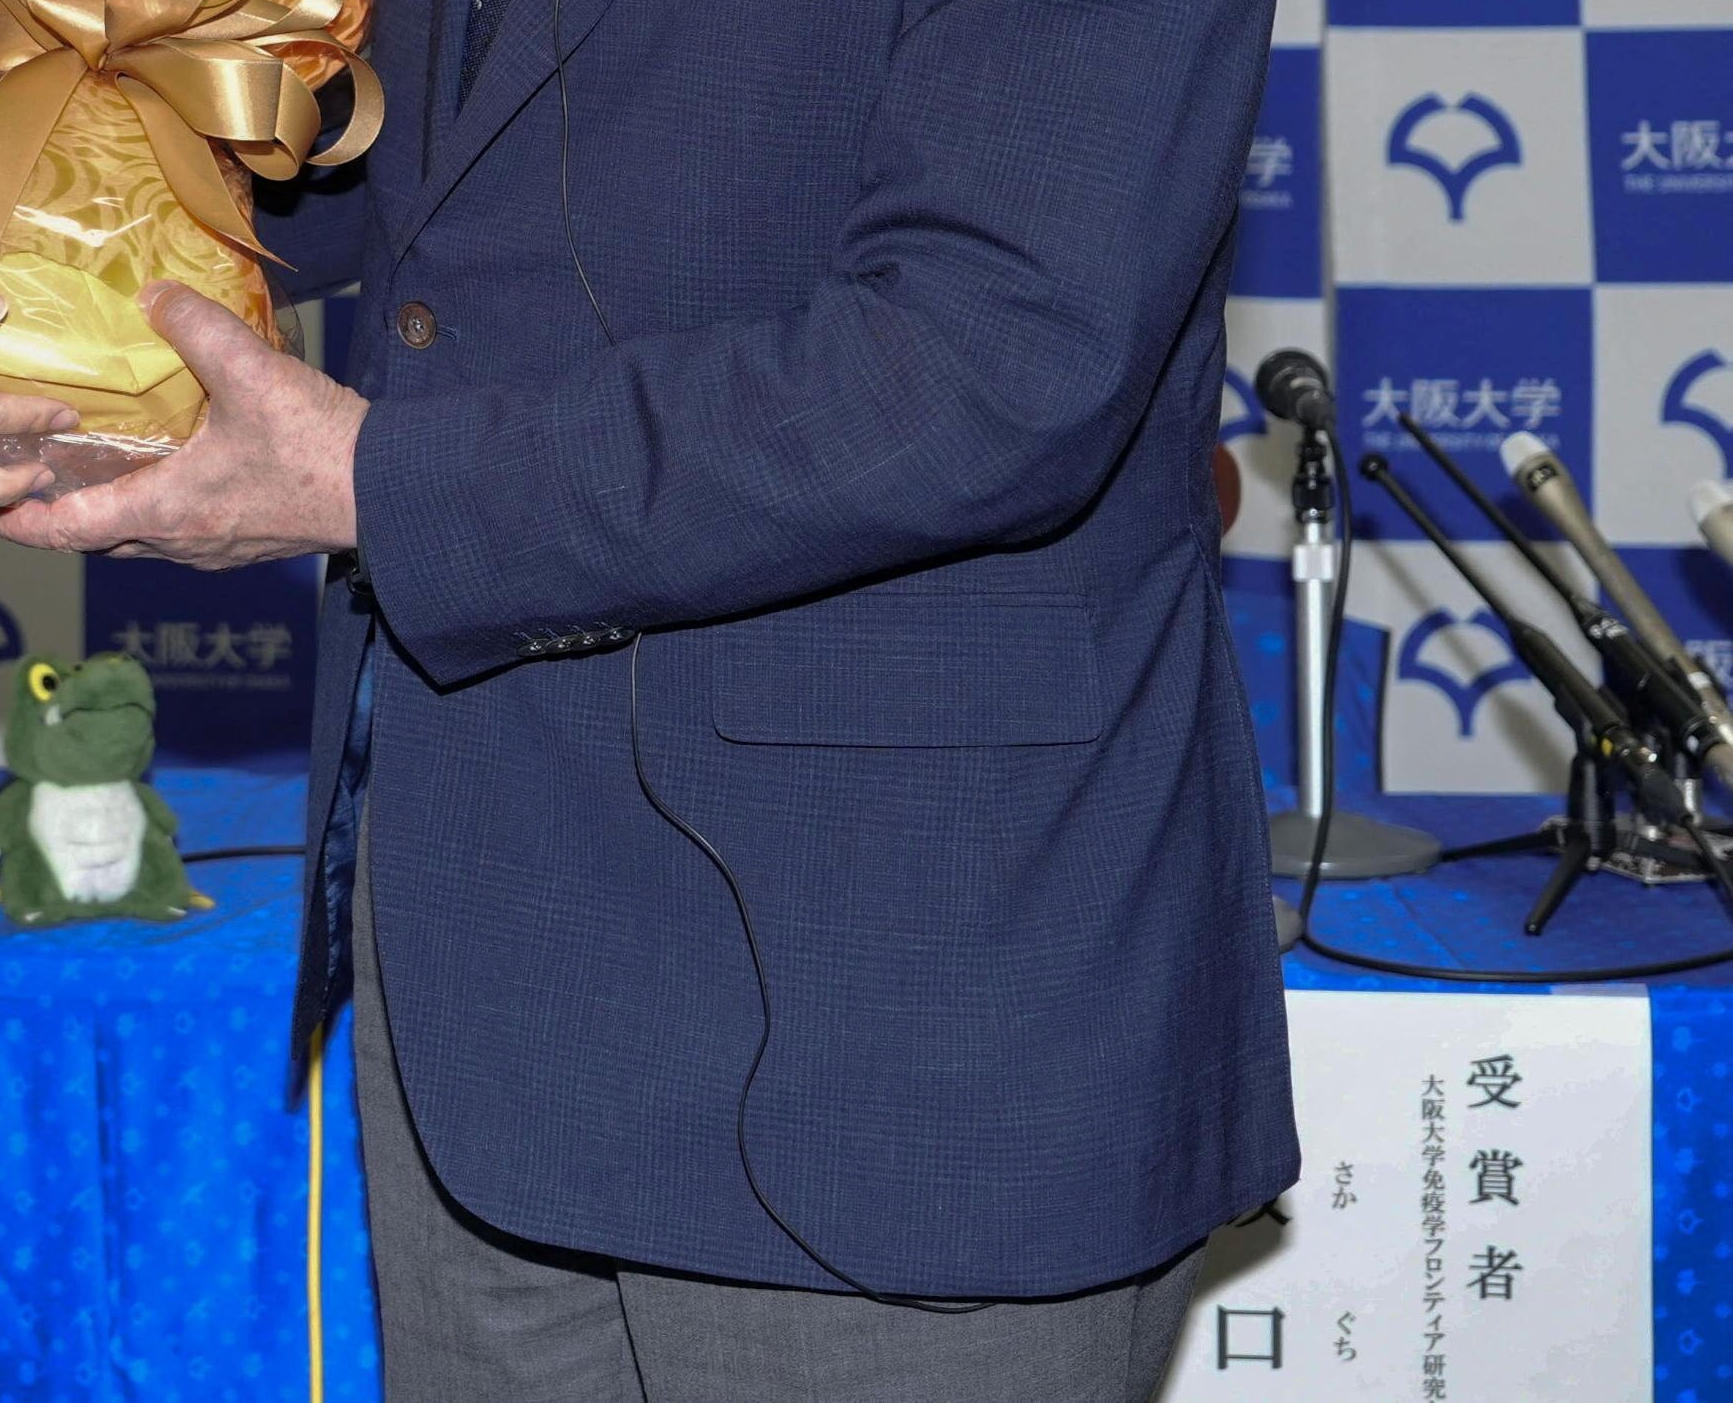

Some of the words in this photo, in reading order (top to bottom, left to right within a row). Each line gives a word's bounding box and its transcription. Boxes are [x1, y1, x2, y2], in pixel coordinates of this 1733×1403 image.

[1621, 119, 1733, 171] 大阪
[1362, 377, 1562, 429] 大阪大学
[112, 620, 292, 668] 大阪大学
[1467, 1054, 1524, 1300] 受賞者
[1421, 1074, 1446, 1403] 大阪大学免疫学フロンティア研究
